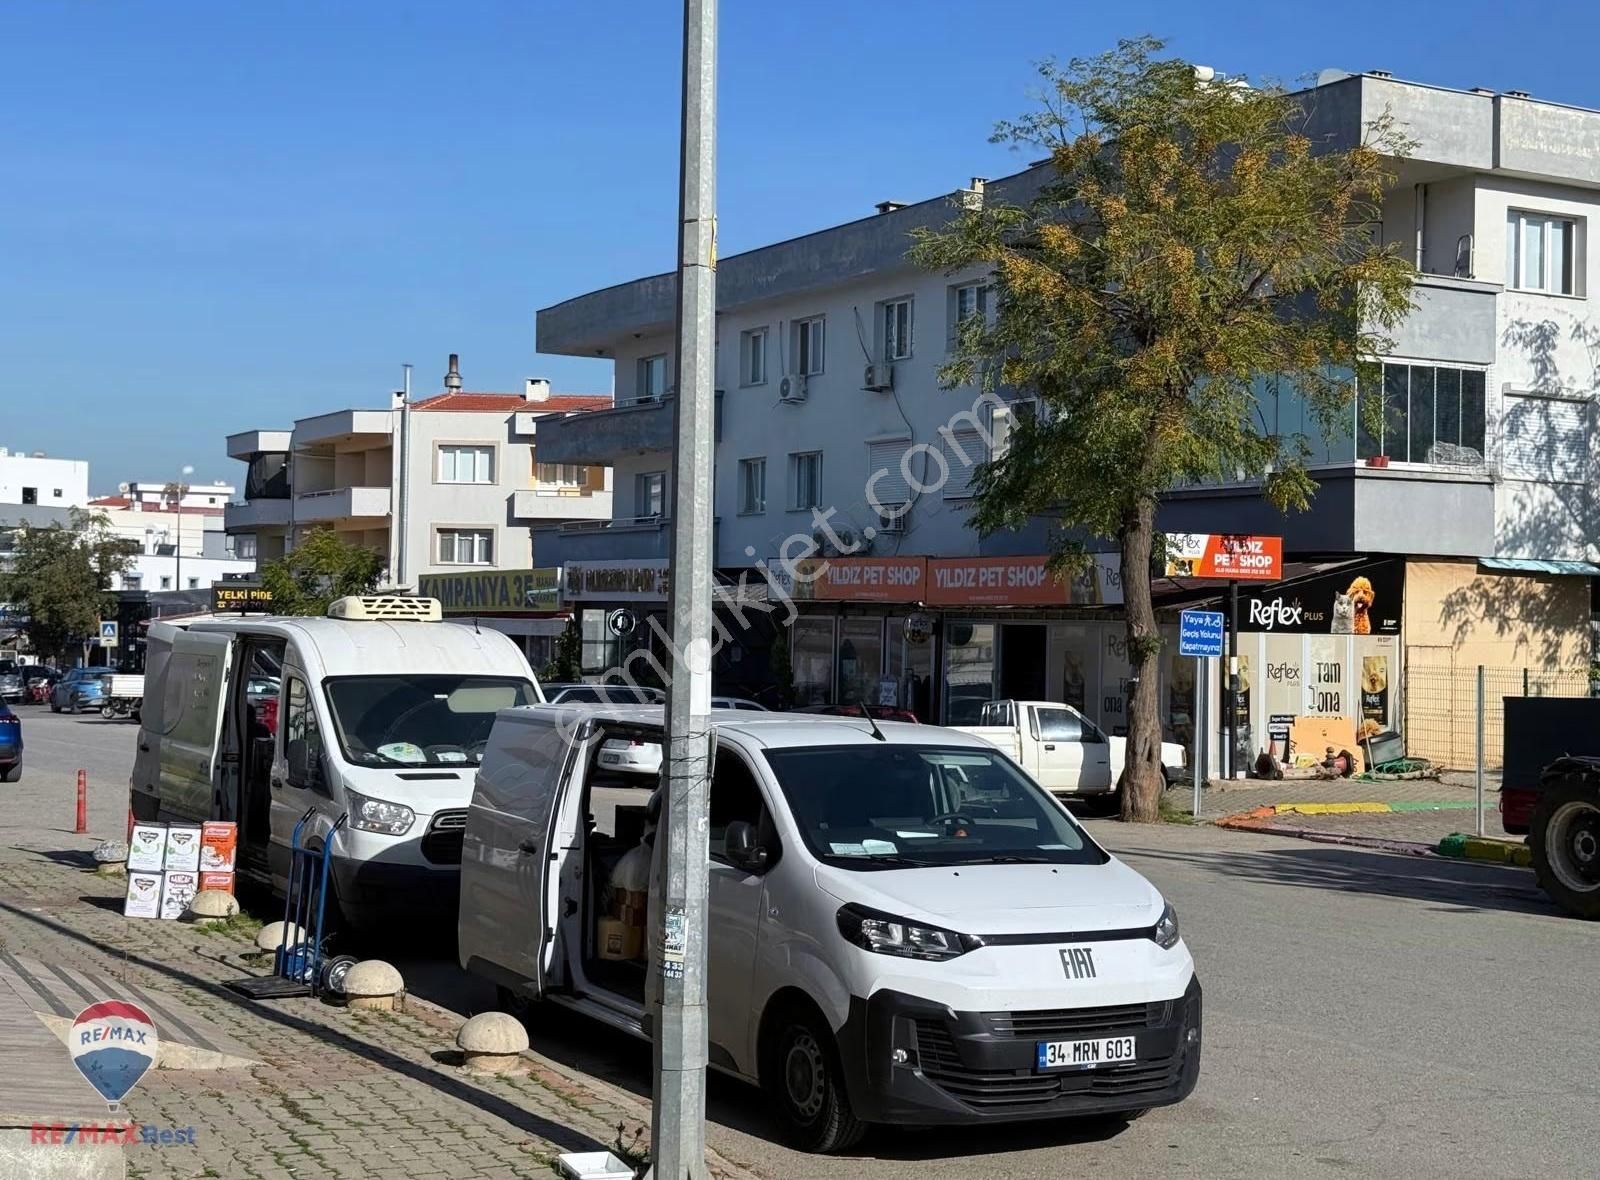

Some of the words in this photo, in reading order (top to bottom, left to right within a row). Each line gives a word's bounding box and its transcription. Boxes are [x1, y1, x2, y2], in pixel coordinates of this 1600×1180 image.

[1214, 553, 1238, 566] PET
[1239, 555, 1273, 568] SHOP
[826, 565, 861, 585] YILDIZ
[863, 565, 886, 585] PET
[887, 565, 921, 586] SHOP
[935, 567, 977, 588] YILDIZ
[978, 566, 1006, 588] PET
[1007, 565, 1047, 587] SHOP
[250, 589, 273, 600] PİDE
[419, 575, 511, 608] KAMPANYA
[1184, 614, 1204, 626] Yaya
[1249, 597, 1303, 631] Reflex
[1303, 611, 1324, 621] PLUS
[1199, 630, 1221, 640] Yolunu
[1267, 661, 1300, 683] Reflex
[1058, 947, 1097, 980] FIAT
[1048, 1043, 1066, 1064] 34
[1073, 1041, 1100, 1063] MRN
[1106, 1039, 1132, 1060] 603
